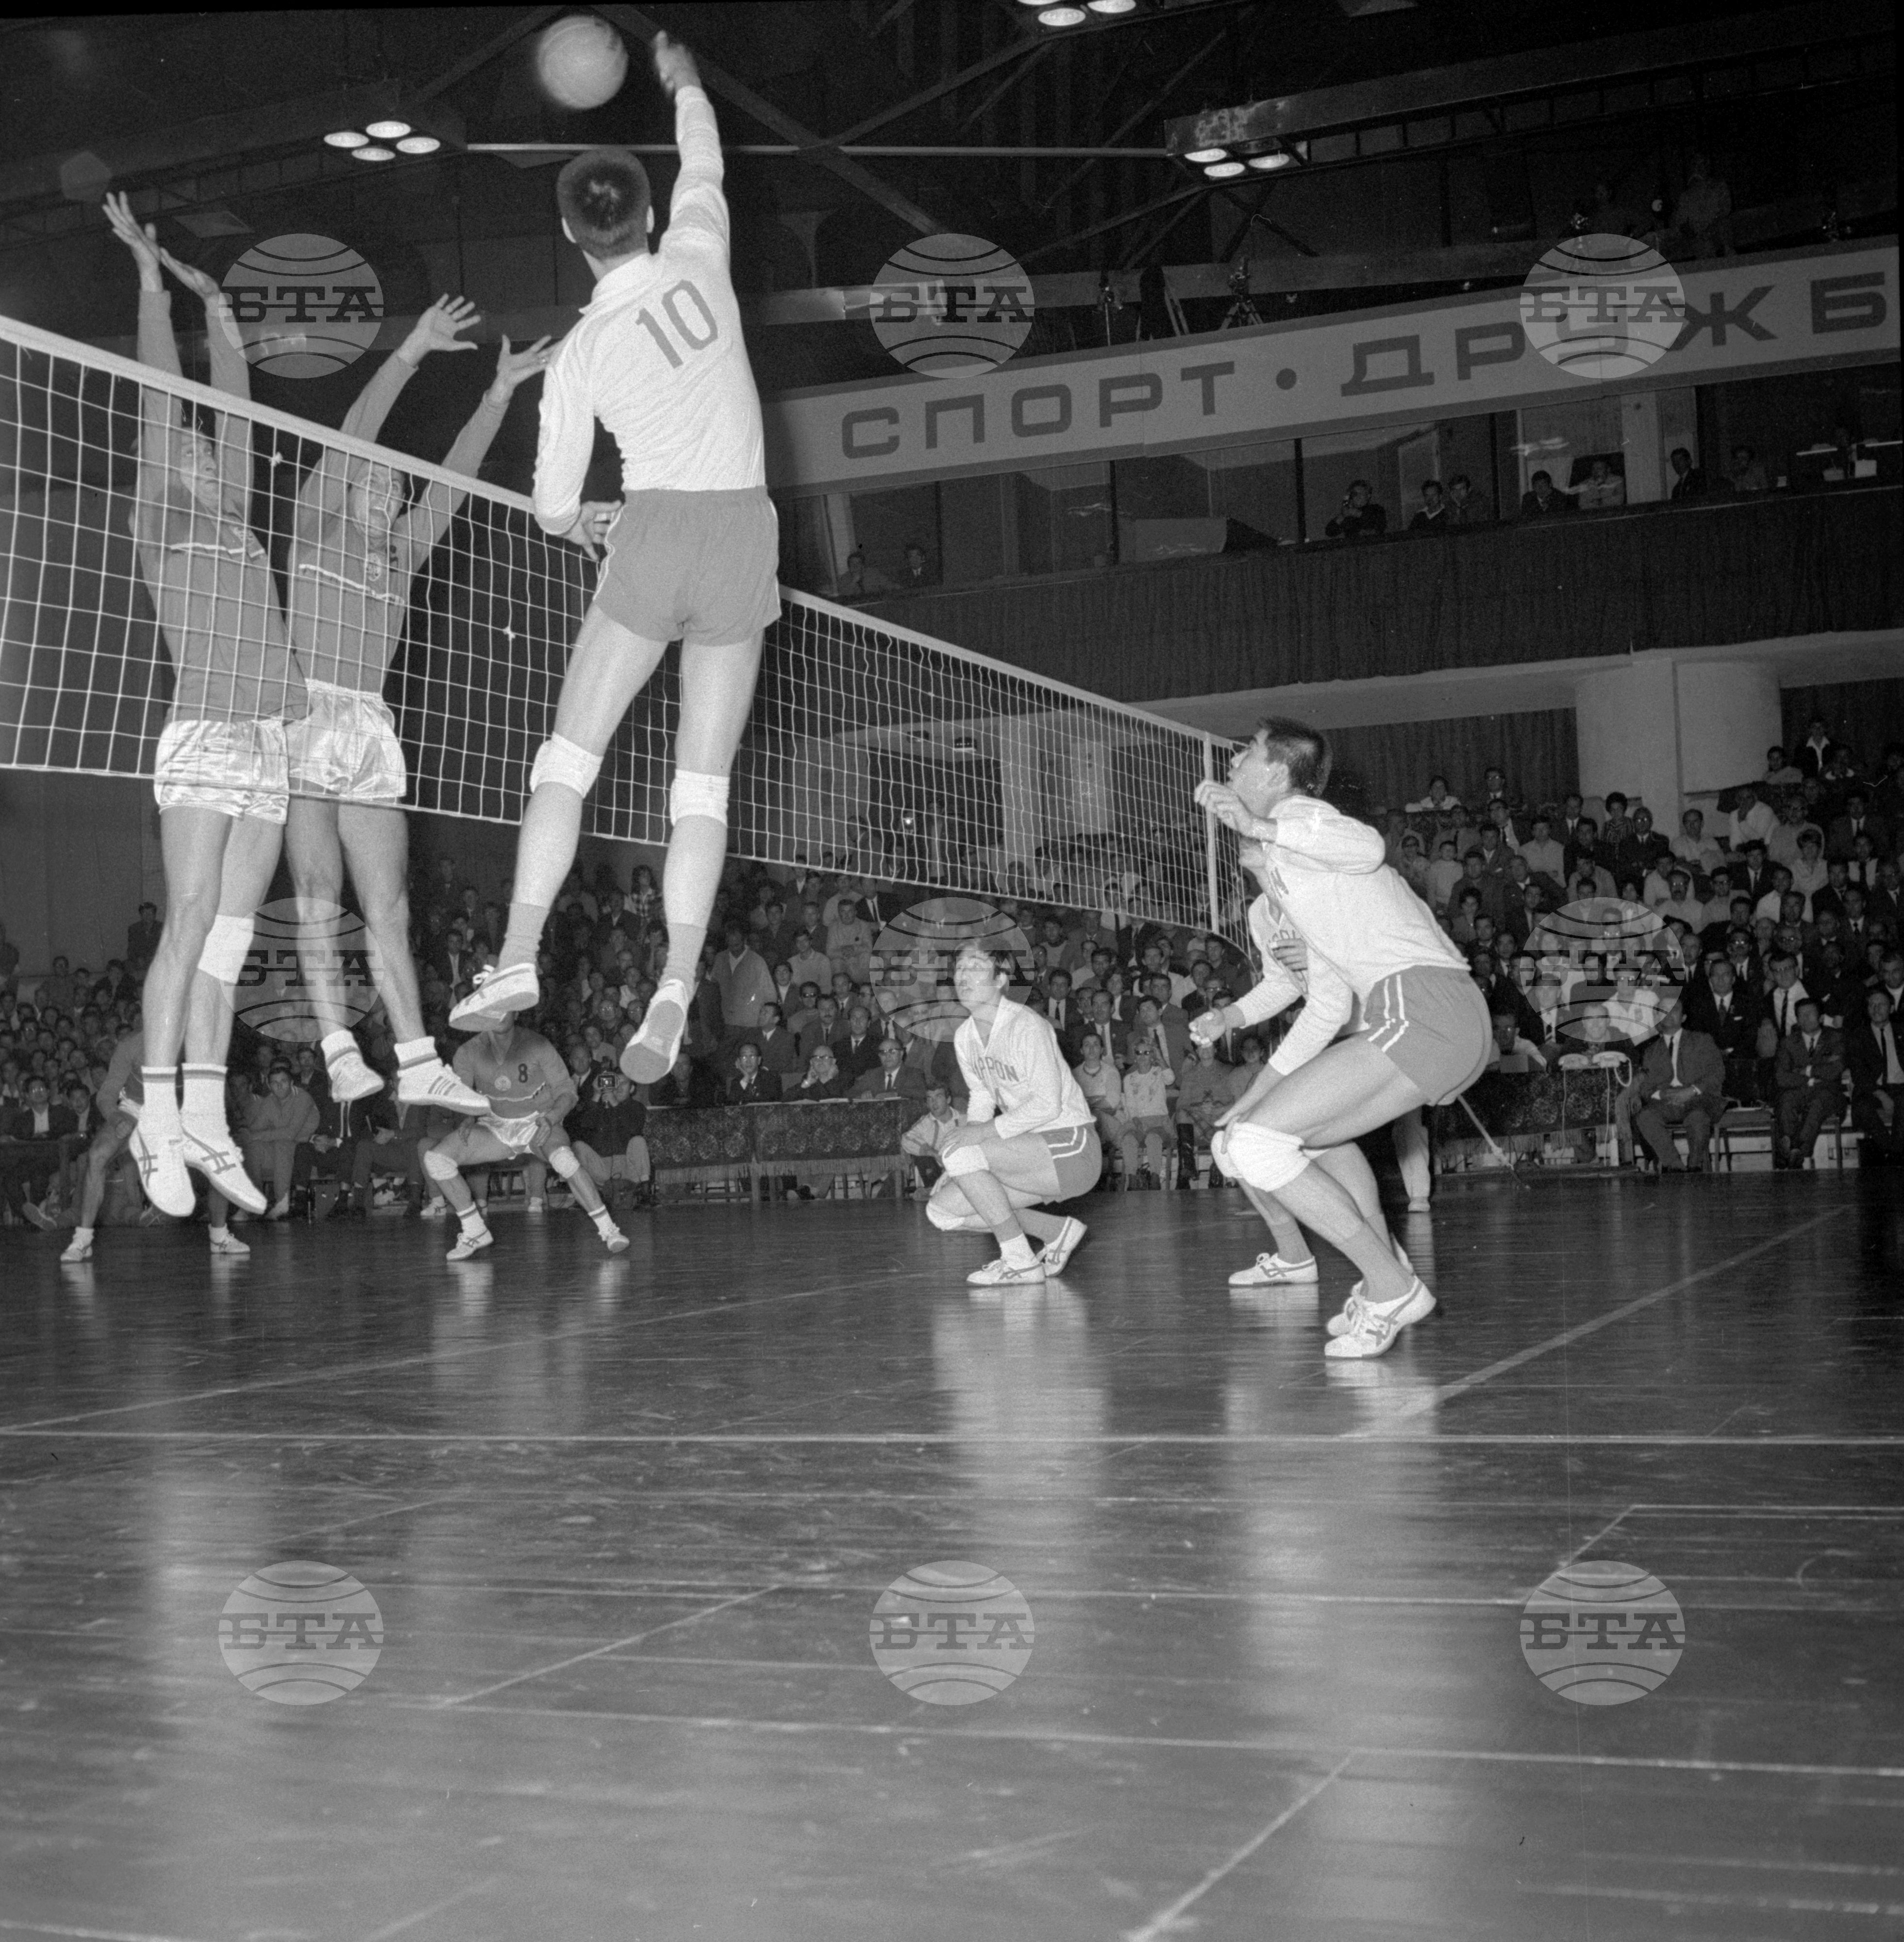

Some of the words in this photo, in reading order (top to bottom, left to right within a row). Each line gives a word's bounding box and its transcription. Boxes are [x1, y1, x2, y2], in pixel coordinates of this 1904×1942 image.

[635, 279, 718, 369] 10
[842, 361, 1235, 459] СПОРТ
[518, 1063, 528, 1083] 8
